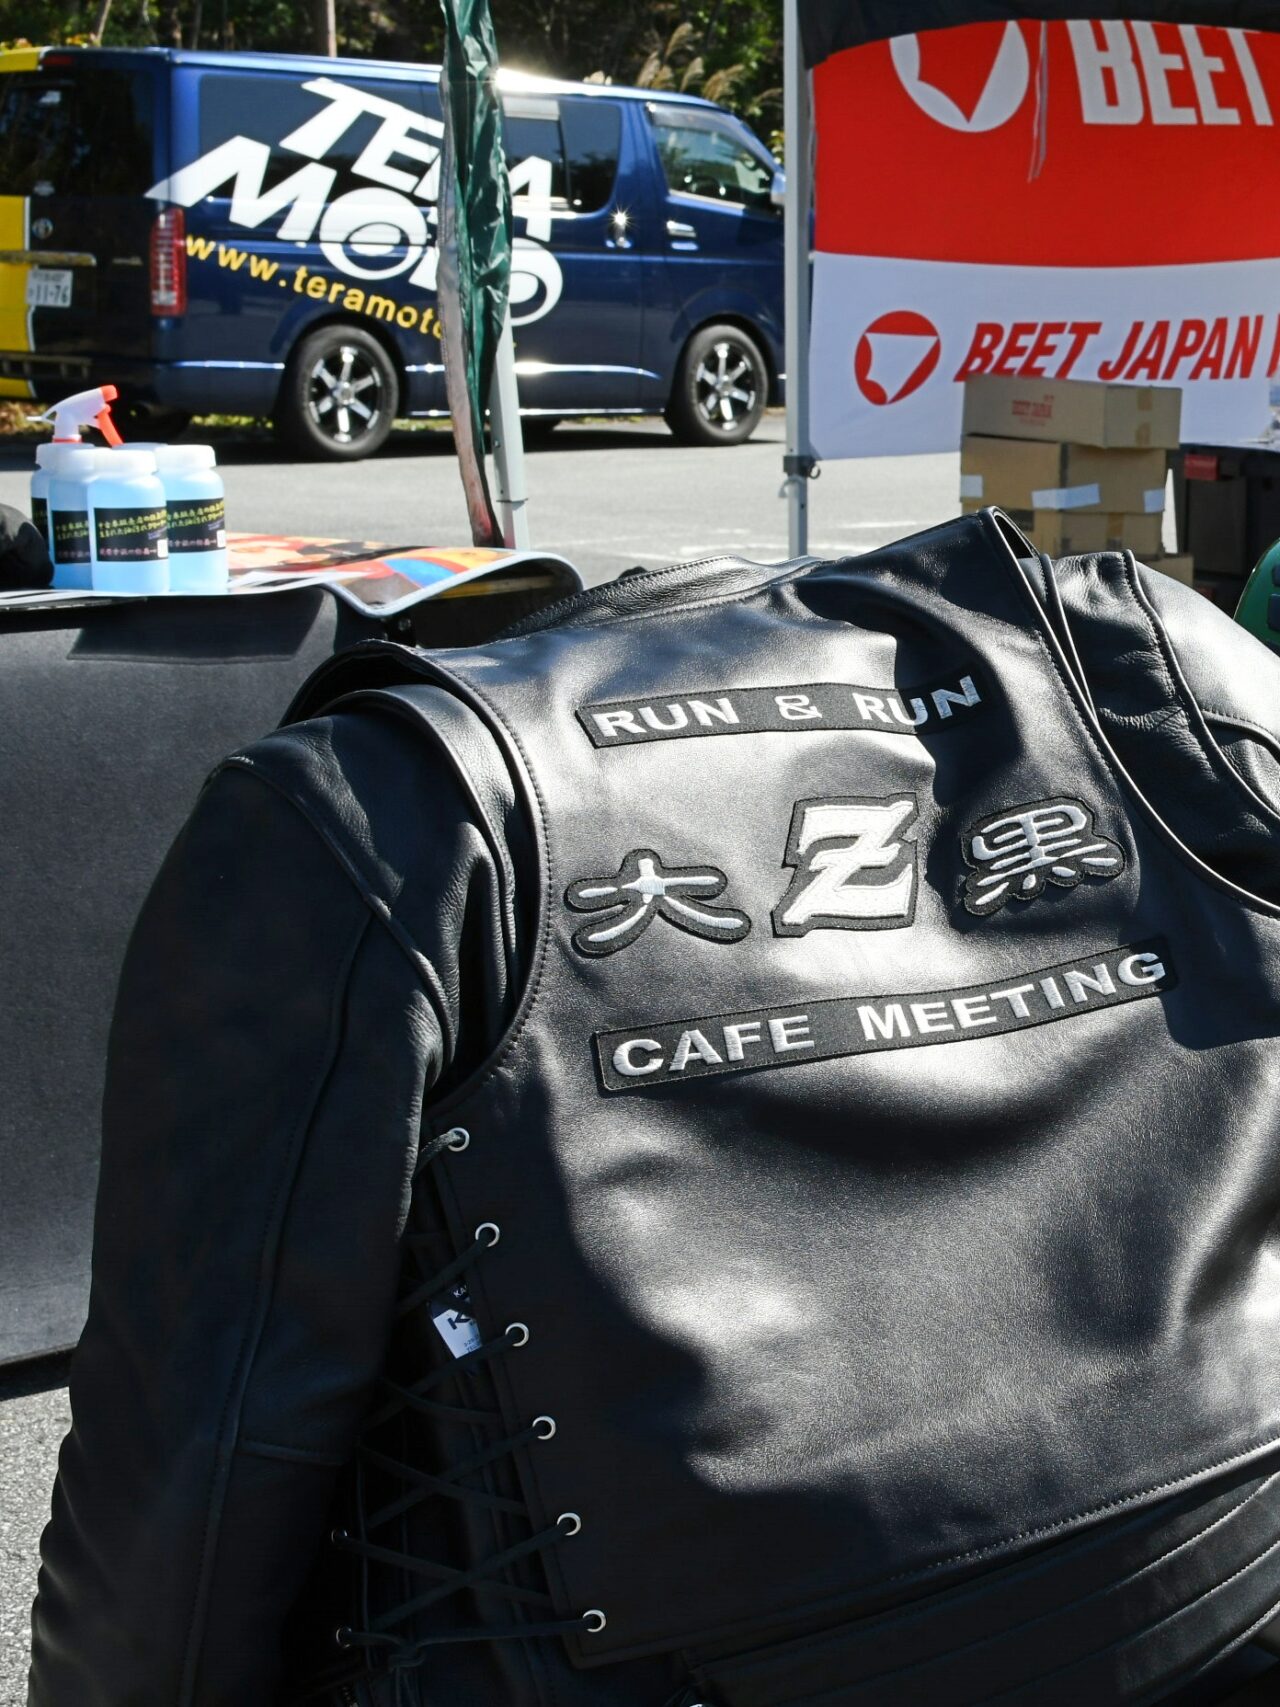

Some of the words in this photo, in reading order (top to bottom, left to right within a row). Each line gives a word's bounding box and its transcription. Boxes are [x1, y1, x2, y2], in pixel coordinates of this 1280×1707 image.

[1066, 19, 1274, 126] BEET
[278, 77, 553, 243] TEA
[953, 321, 1102, 382] BEET
[1098, 313, 1264, 383] JAPAN
[593, 697, 739, 740] RUN
[778, 693, 823, 721] &
[859, 674, 983, 727] RUN
[577, 857, 744, 944] 大
[782, 800, 917, 926] Z
[612, 1014, 815, 1077] CAFE
[857, 951, 1167, 1042] MEETING
